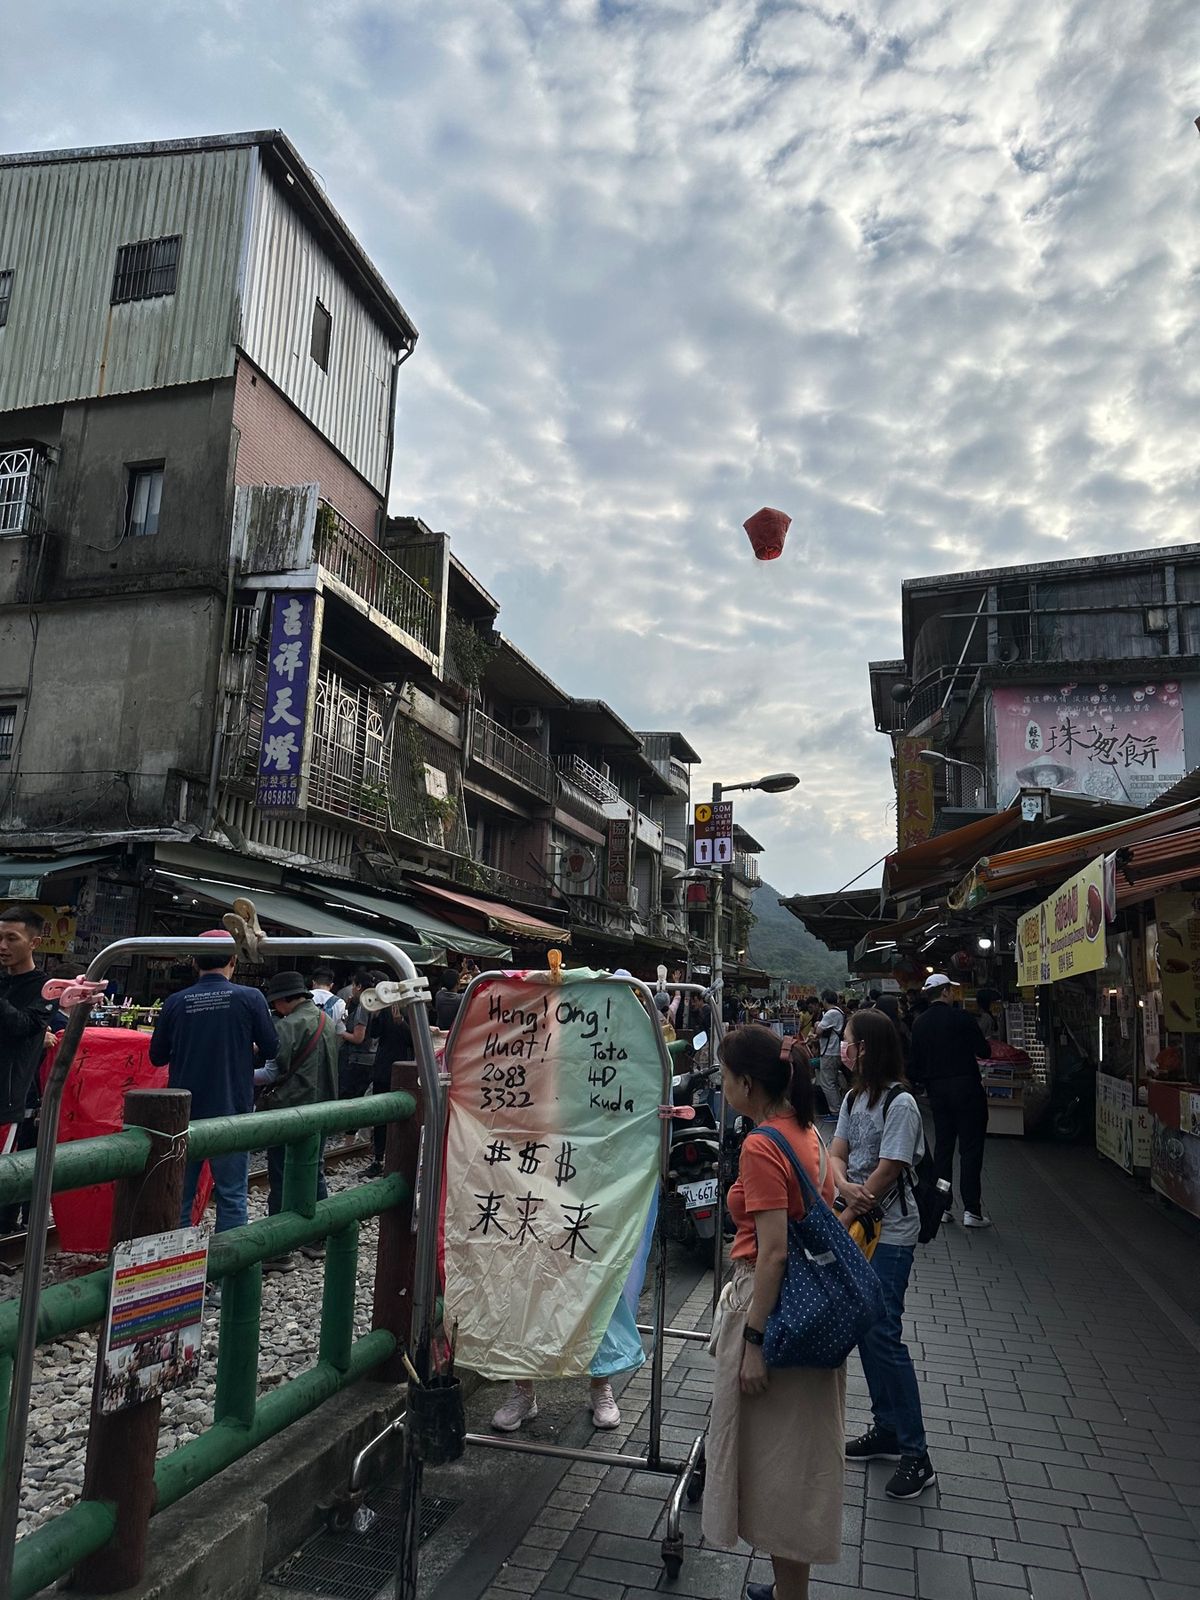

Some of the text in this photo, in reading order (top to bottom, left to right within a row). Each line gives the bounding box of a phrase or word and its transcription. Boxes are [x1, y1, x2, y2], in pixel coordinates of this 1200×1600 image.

[263, 598, 304, 770] 吉祥天燈
[713, 805, 731, 813] 50M
[488, 995, 611, 1039] Heng! Ong!
[483, 1033, 552, 1063] Huat!
[481, 1063, 527, 1088] 2083
[588, 1066, 617, 1088] 4D
[480, 1087, 535, 1112] 3322
